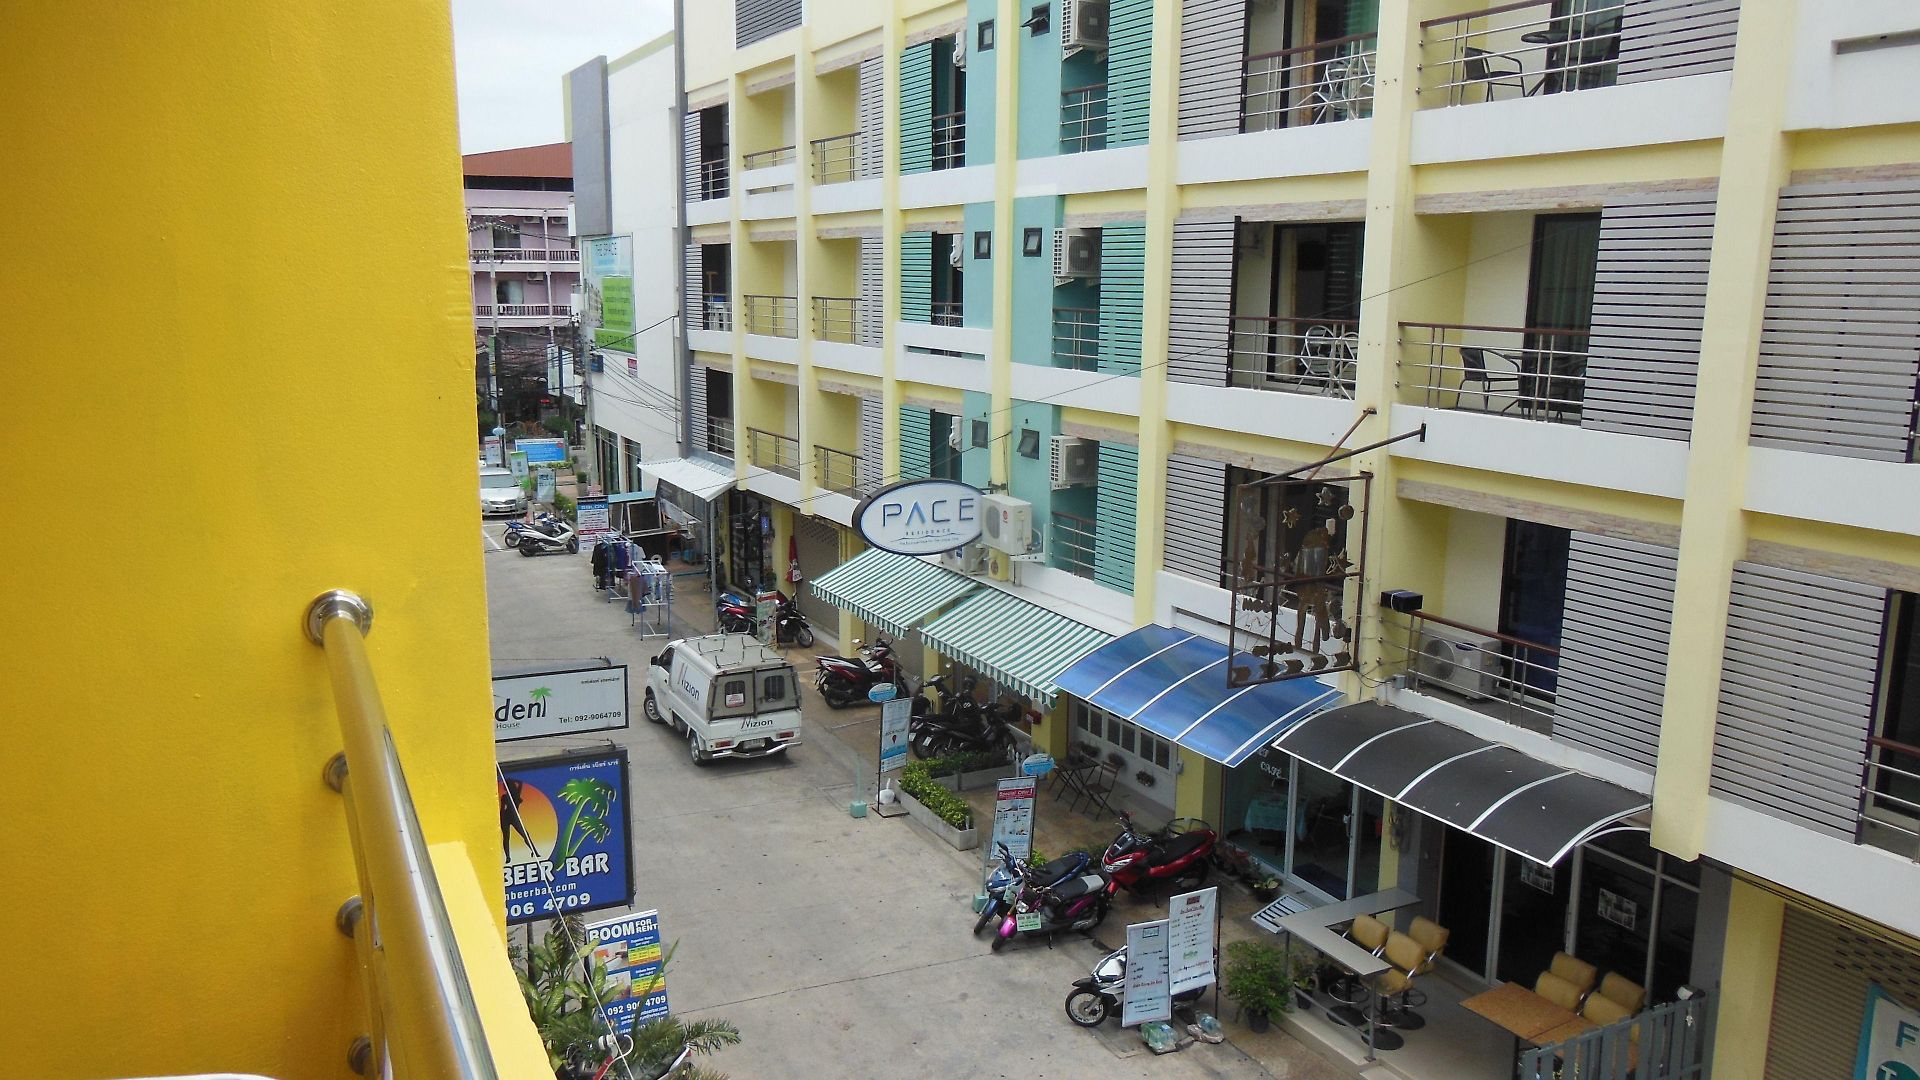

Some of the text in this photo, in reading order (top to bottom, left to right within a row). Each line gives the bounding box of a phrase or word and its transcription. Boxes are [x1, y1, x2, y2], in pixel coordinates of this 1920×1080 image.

[883, 499, 974, 527] PACE
[565, 852, 610, 877] BAR
[543, 892, 591, 911] 4709
[636, 918, 652, 927] FOR
[636, 923, 659, 934] RENT
[607, 1005, 624, 1016] 092
[645, 995, 666, 1006] 4709
